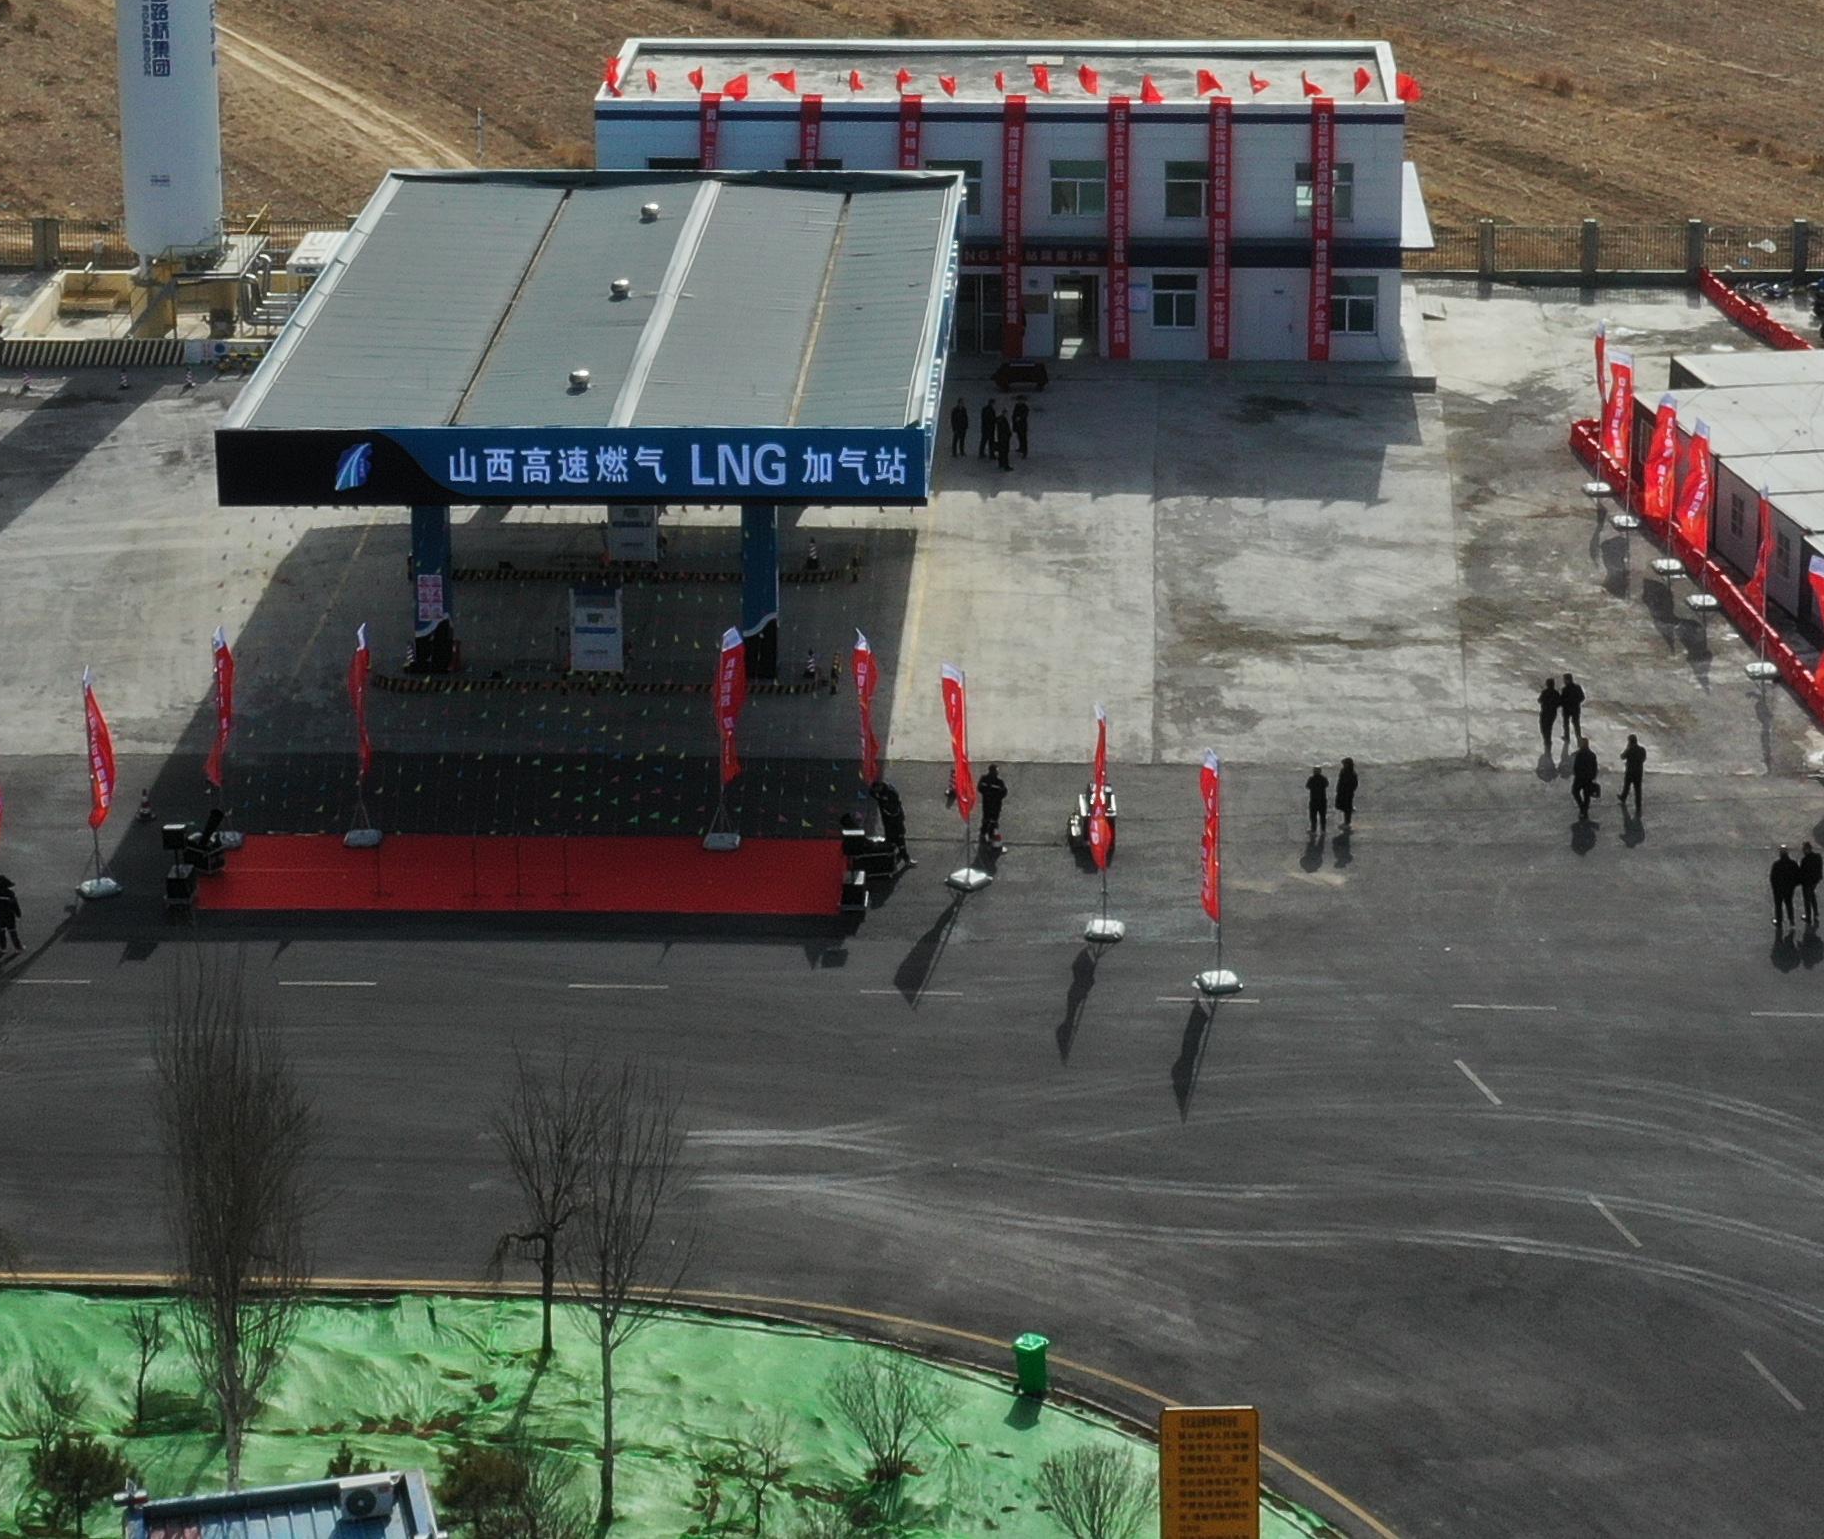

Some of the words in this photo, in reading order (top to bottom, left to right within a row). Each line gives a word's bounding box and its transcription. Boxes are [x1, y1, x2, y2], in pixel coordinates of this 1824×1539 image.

[449, 446, 666, 484] 山西高速燃气
[691, 444, 786, 486] LNG
[802, 447, 906, 485] 加气站
